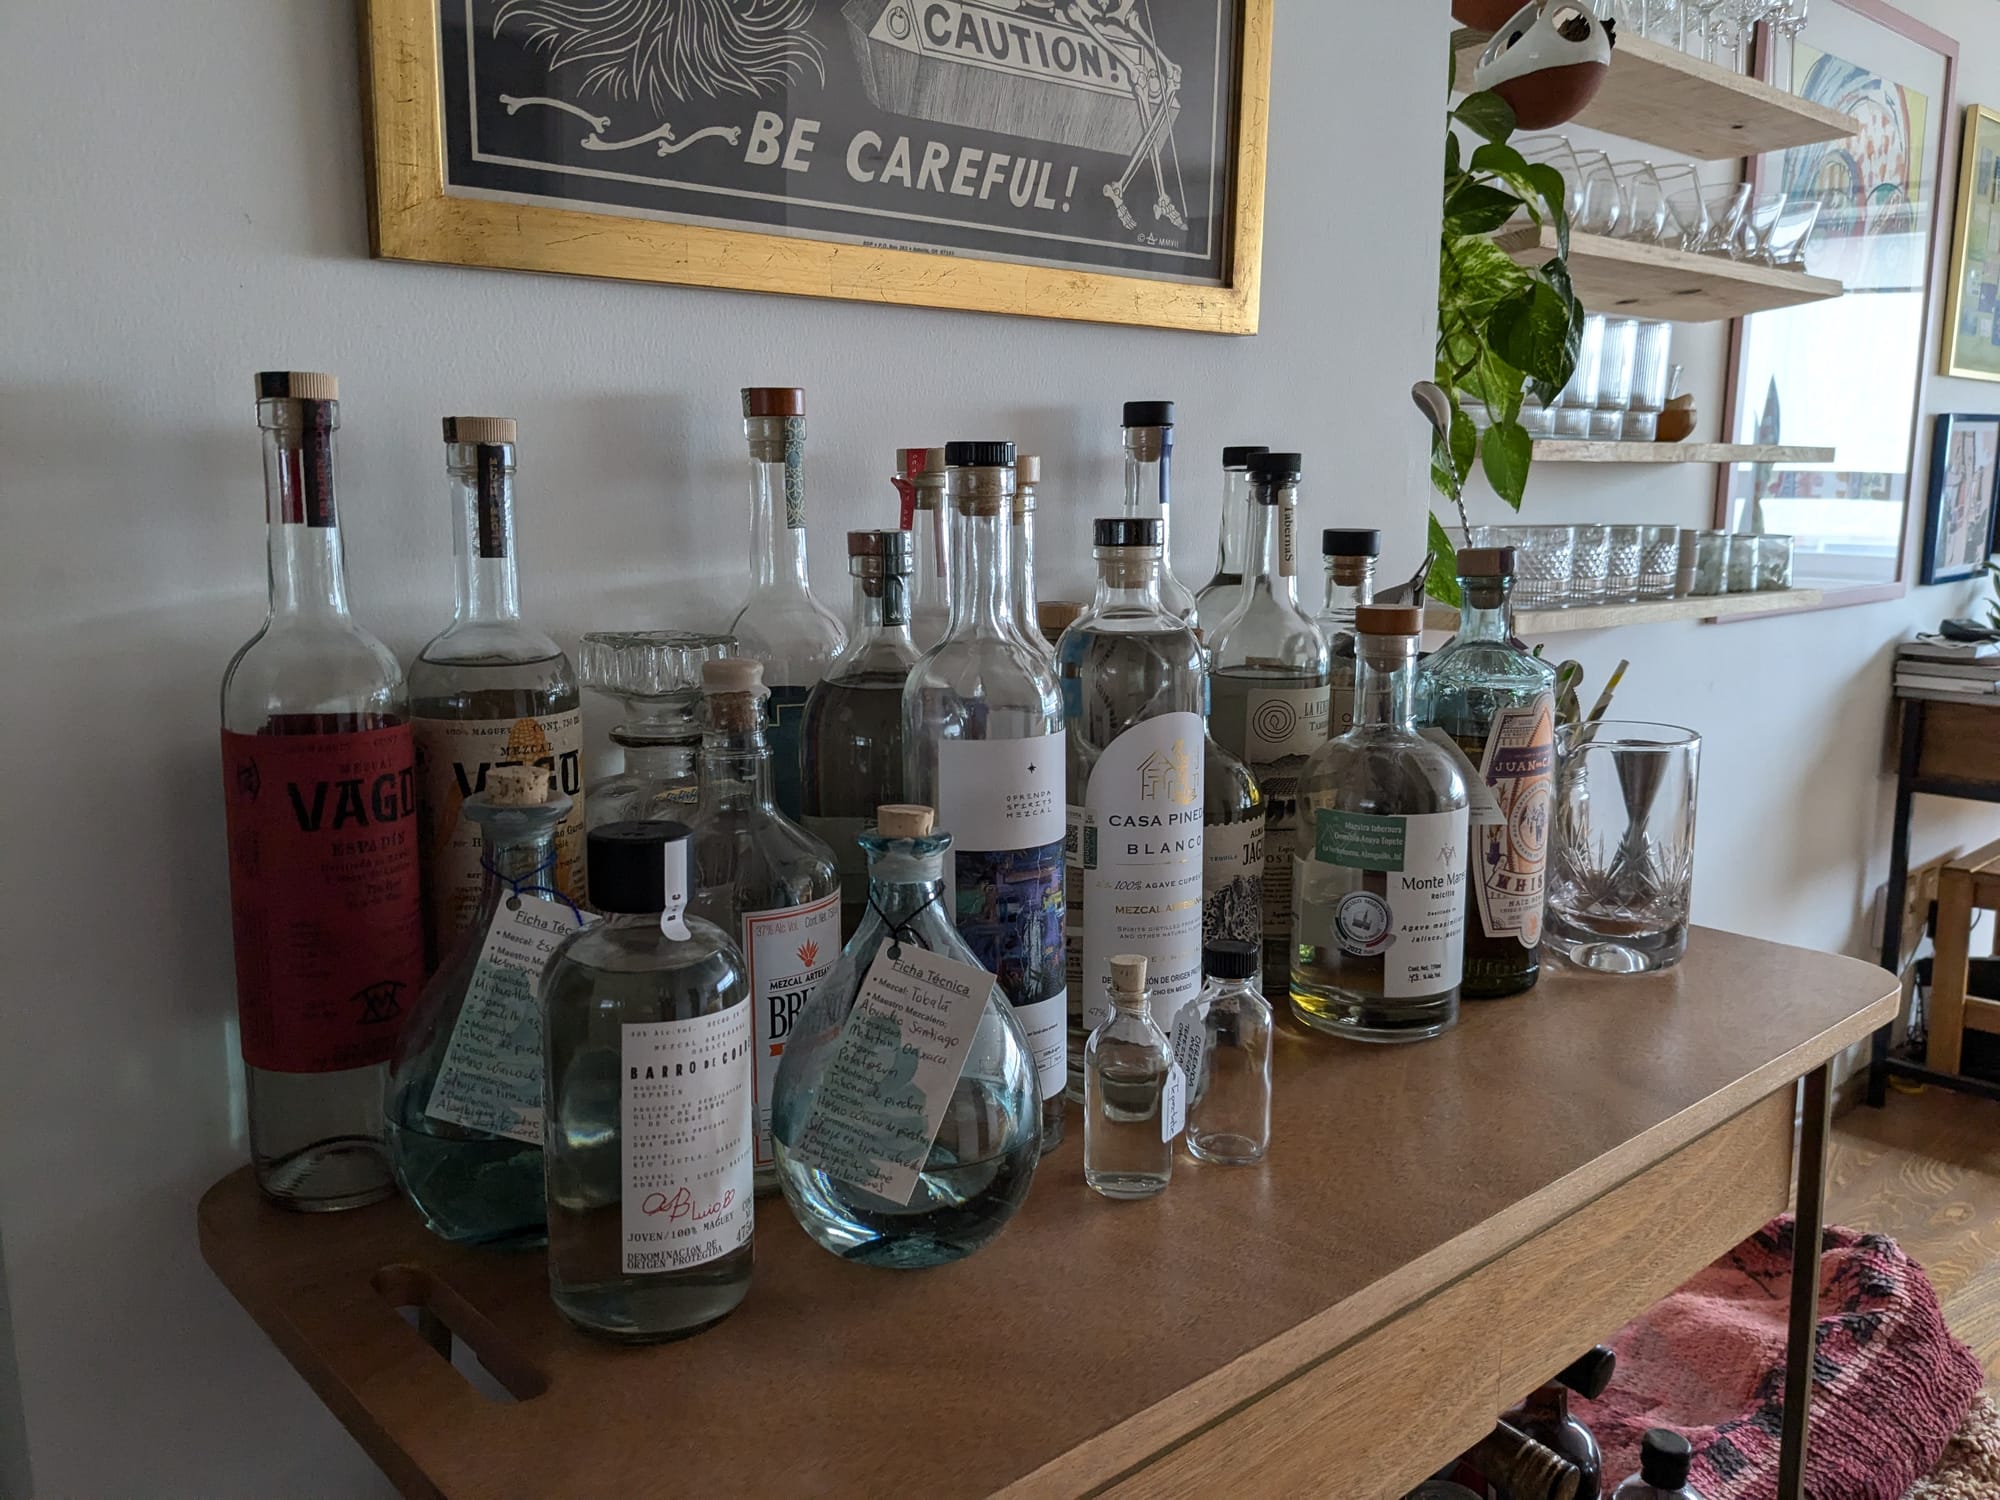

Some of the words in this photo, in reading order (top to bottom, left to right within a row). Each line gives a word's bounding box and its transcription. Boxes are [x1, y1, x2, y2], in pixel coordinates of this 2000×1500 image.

[923, 3, 1120, 84] CAUTION!
[744, 110, 821, 172] BE
[846, 130, 1079, 213] CAREFUL!
[500, 742, 555, 757] MEZCAL
[1495, 759, 1536, 773] JUAN
[287, 766, 416, 832] VAGO
[1006, 790, 1051, 802] OFRENDA
[1006, 798, 1052, 810] SPIRITS
[1006, 807, 1052, 818] MEZCAL
[1109, 815, 1162, 827] CASA
[1127, 835, 1201, 855] BLANCO
[1242, 840, 1263, 866] JAG
[1114, 880, 1142, 890] 100%
[1145, 881, 1176, 889] AGAVE
[1401, 876, 1444, 891] Monte
[1495, 873, 1543, 892] WHIS
[1431, 890, 1455, 900] Raicilla
[1115, 905, 1162, 915] MEZCAL
[515, 911, 548, 929] Ficha
[552, 920, 573, 936] Téc
[756, 925, 774, 937] 37%
[1401, 924, 1429, 932] Agave
[497, 946, 530, 962] Maestro
[1347, 944, 1362, 954] 2022
[769, 977, 803, 991] MEZCAL
[892, 960, 924, 979] Ficha
[927, 969, 970, 996] Técnica
[1161, 976, 1170, 984] DE
[1171, 971, 1191, 981] ORIGEN
[871, 992, 904, 1012] Maestro
[909, 1020, 960, 1049] Santiago
[654, 1041, 697, 1051] MEZCAL
[630, 1061, 696, 1080] BARRO
[704, 1057, 716, 1069] DE
[633, 1112, 668, 1120] OLLAS
[670, 1113, 702, 1125] COBRE
[627, 1226, 698, 1242] JOVEN/100%
[703, 1211, 734, 1231] MAGUEY
[627, 1245, 702, 1261] DENOMINACIÓN
[706, 1239, 717, 1250] DE
[627, 1259, 666, 1270] ORIGEN
[672, 1244, 723, 1267] PROTEGIDA
